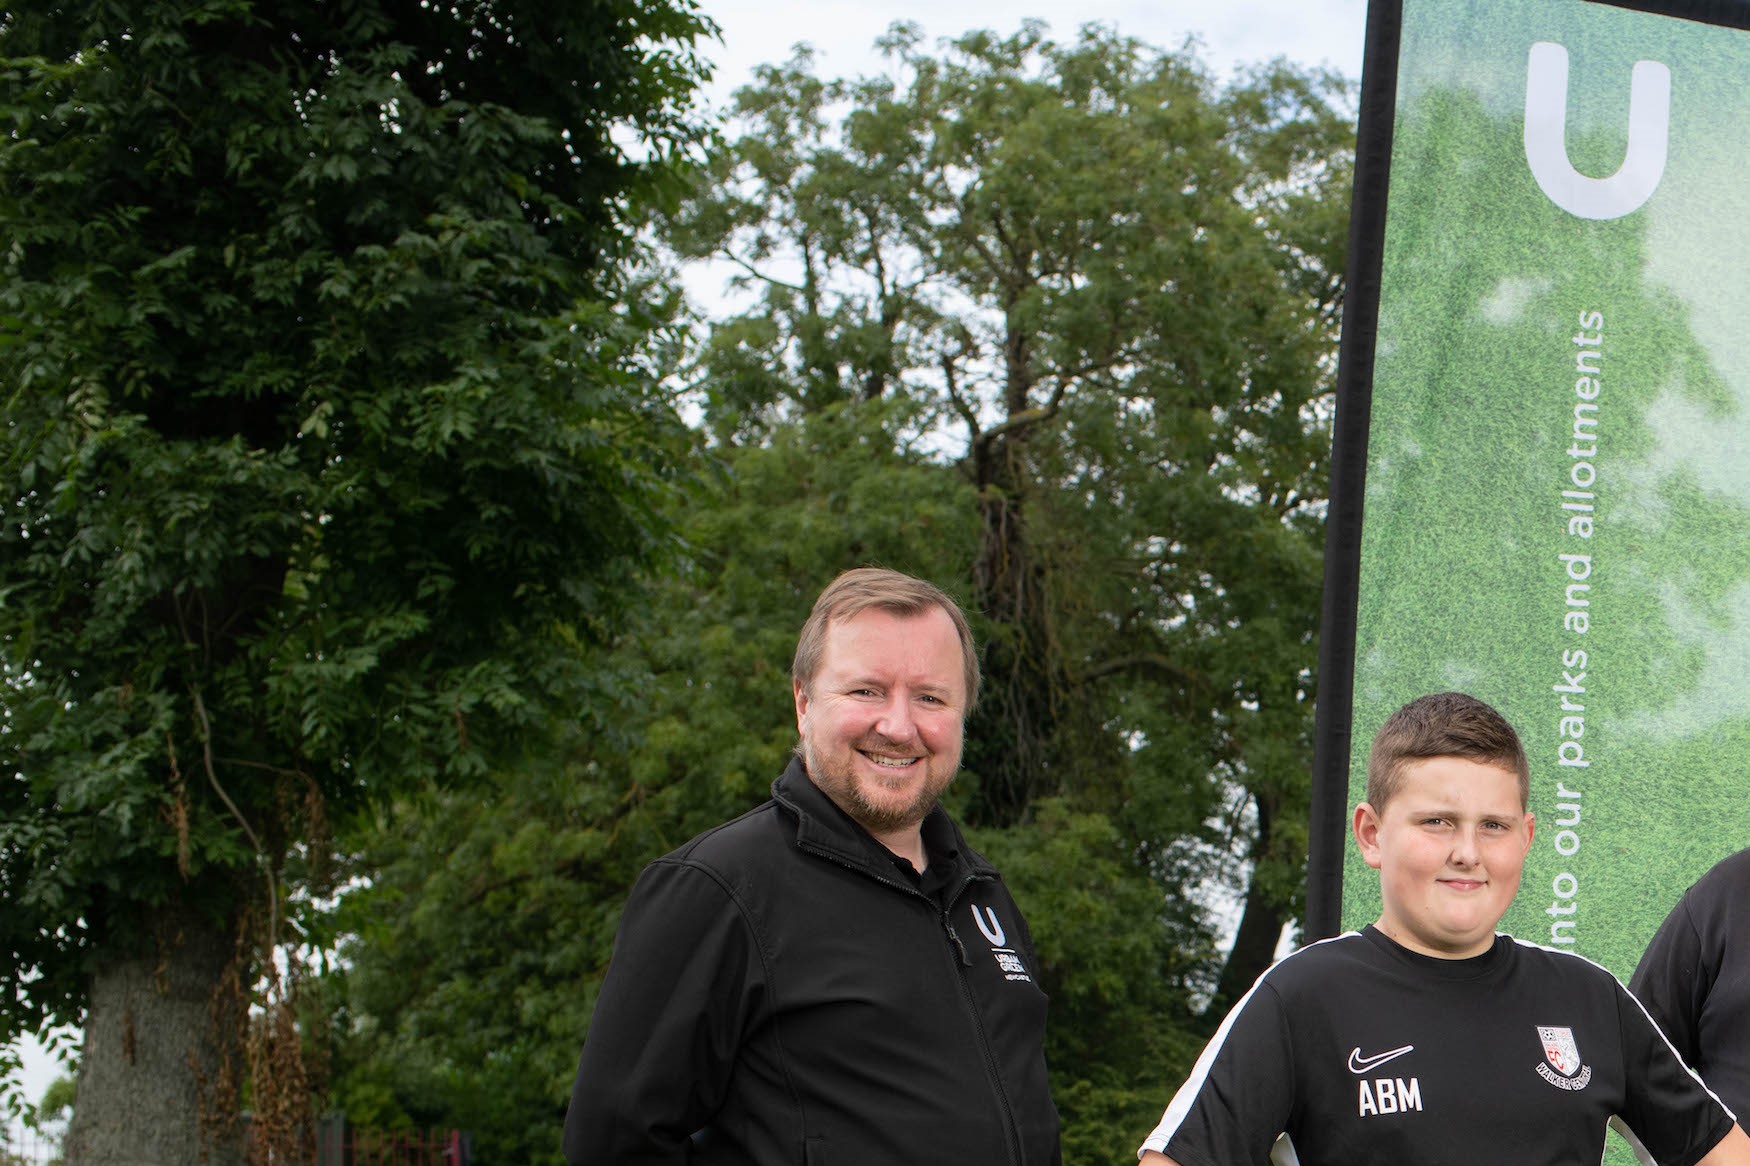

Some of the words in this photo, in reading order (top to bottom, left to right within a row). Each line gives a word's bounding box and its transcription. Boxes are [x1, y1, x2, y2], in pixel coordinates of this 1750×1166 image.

[1523, 41, 1671, 220] U
[1561, 309, 1604, 539] allotments
[1558, 553, 1592, 634] and
[1553, 647, 1590, 767] parks
[1554, 783, 1582, 856] our
[970, 903, 1007, 947] U
[1545, 872, 1579, 944] nto
[1359, 1077, 1423, 1117] ABM
[1535, 1062, 1572, 1090] WALKER
